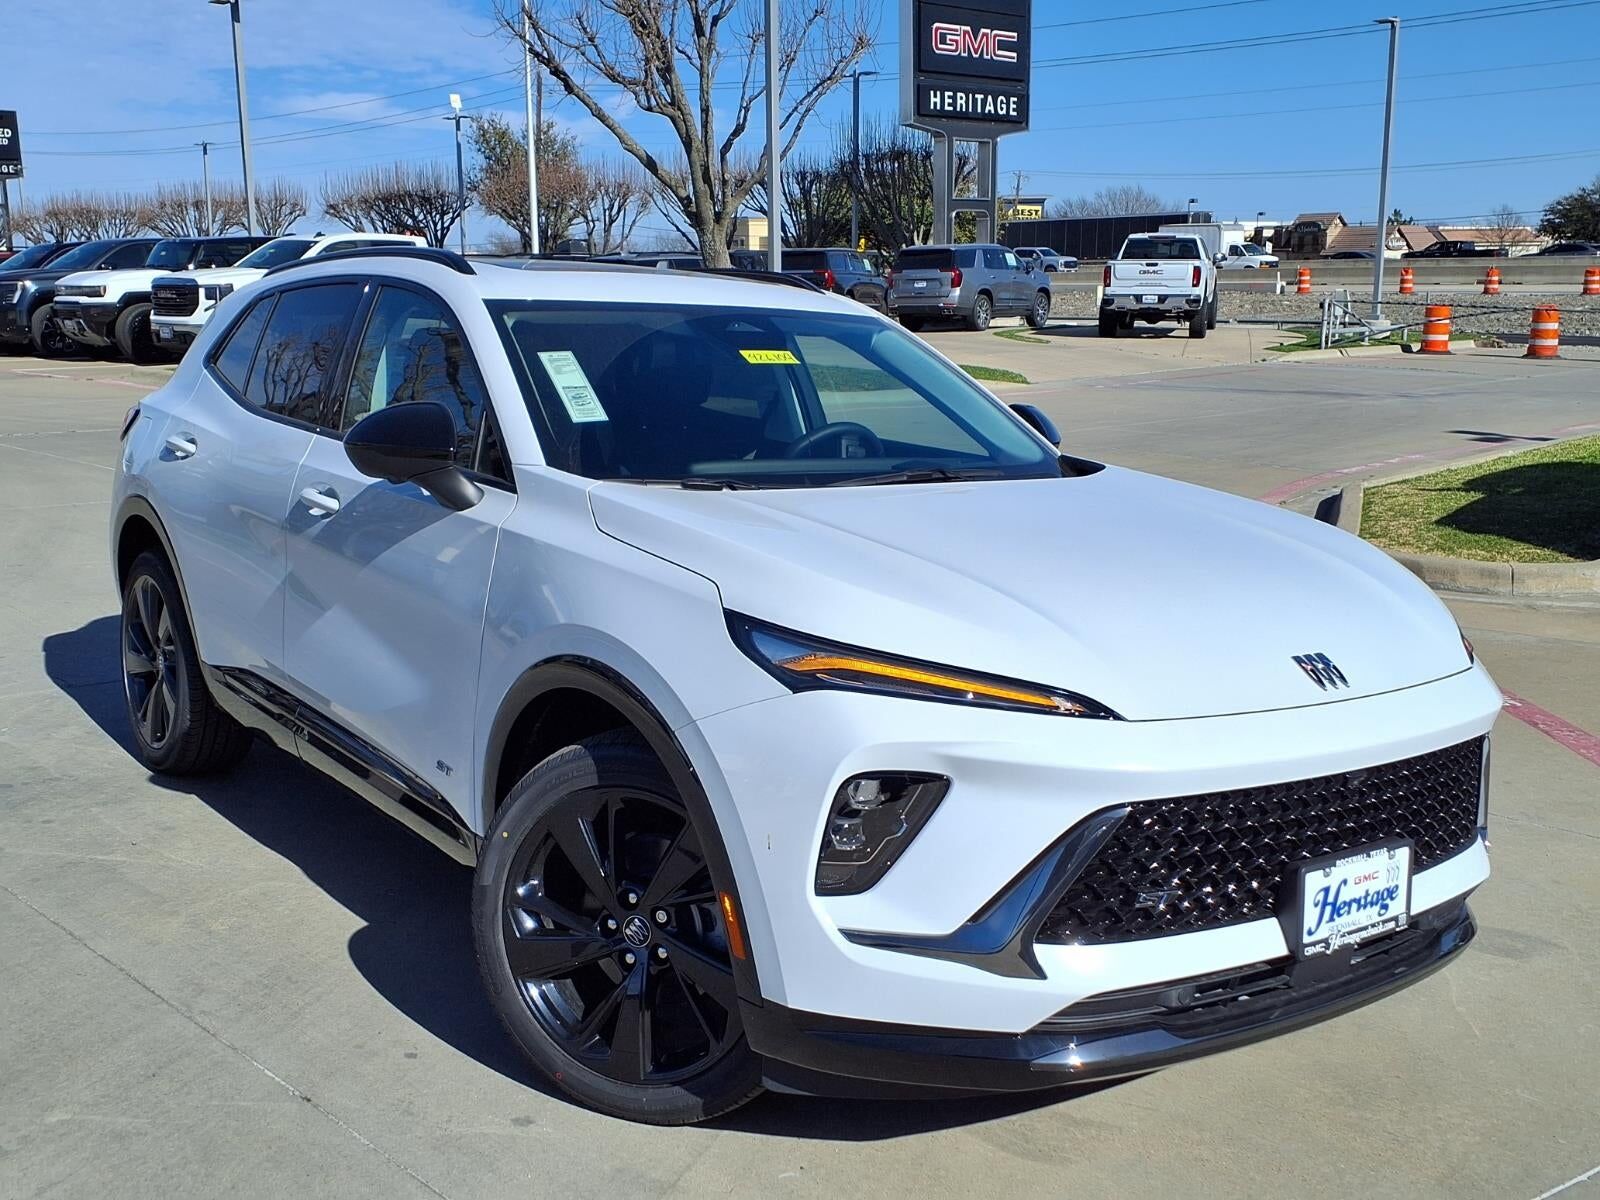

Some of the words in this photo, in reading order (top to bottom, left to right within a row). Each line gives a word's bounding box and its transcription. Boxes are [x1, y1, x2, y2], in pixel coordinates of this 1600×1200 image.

[932, 22, 1018, 63] GMC
[929, 90, 1018, 116] HERITAGE
[436, 760, 454, 777] ST
[1354, 870, 1380, 885] GMC
[1306, 878, 1399, 937] Heritage
[1304, 943, 1326, 956] GMC
